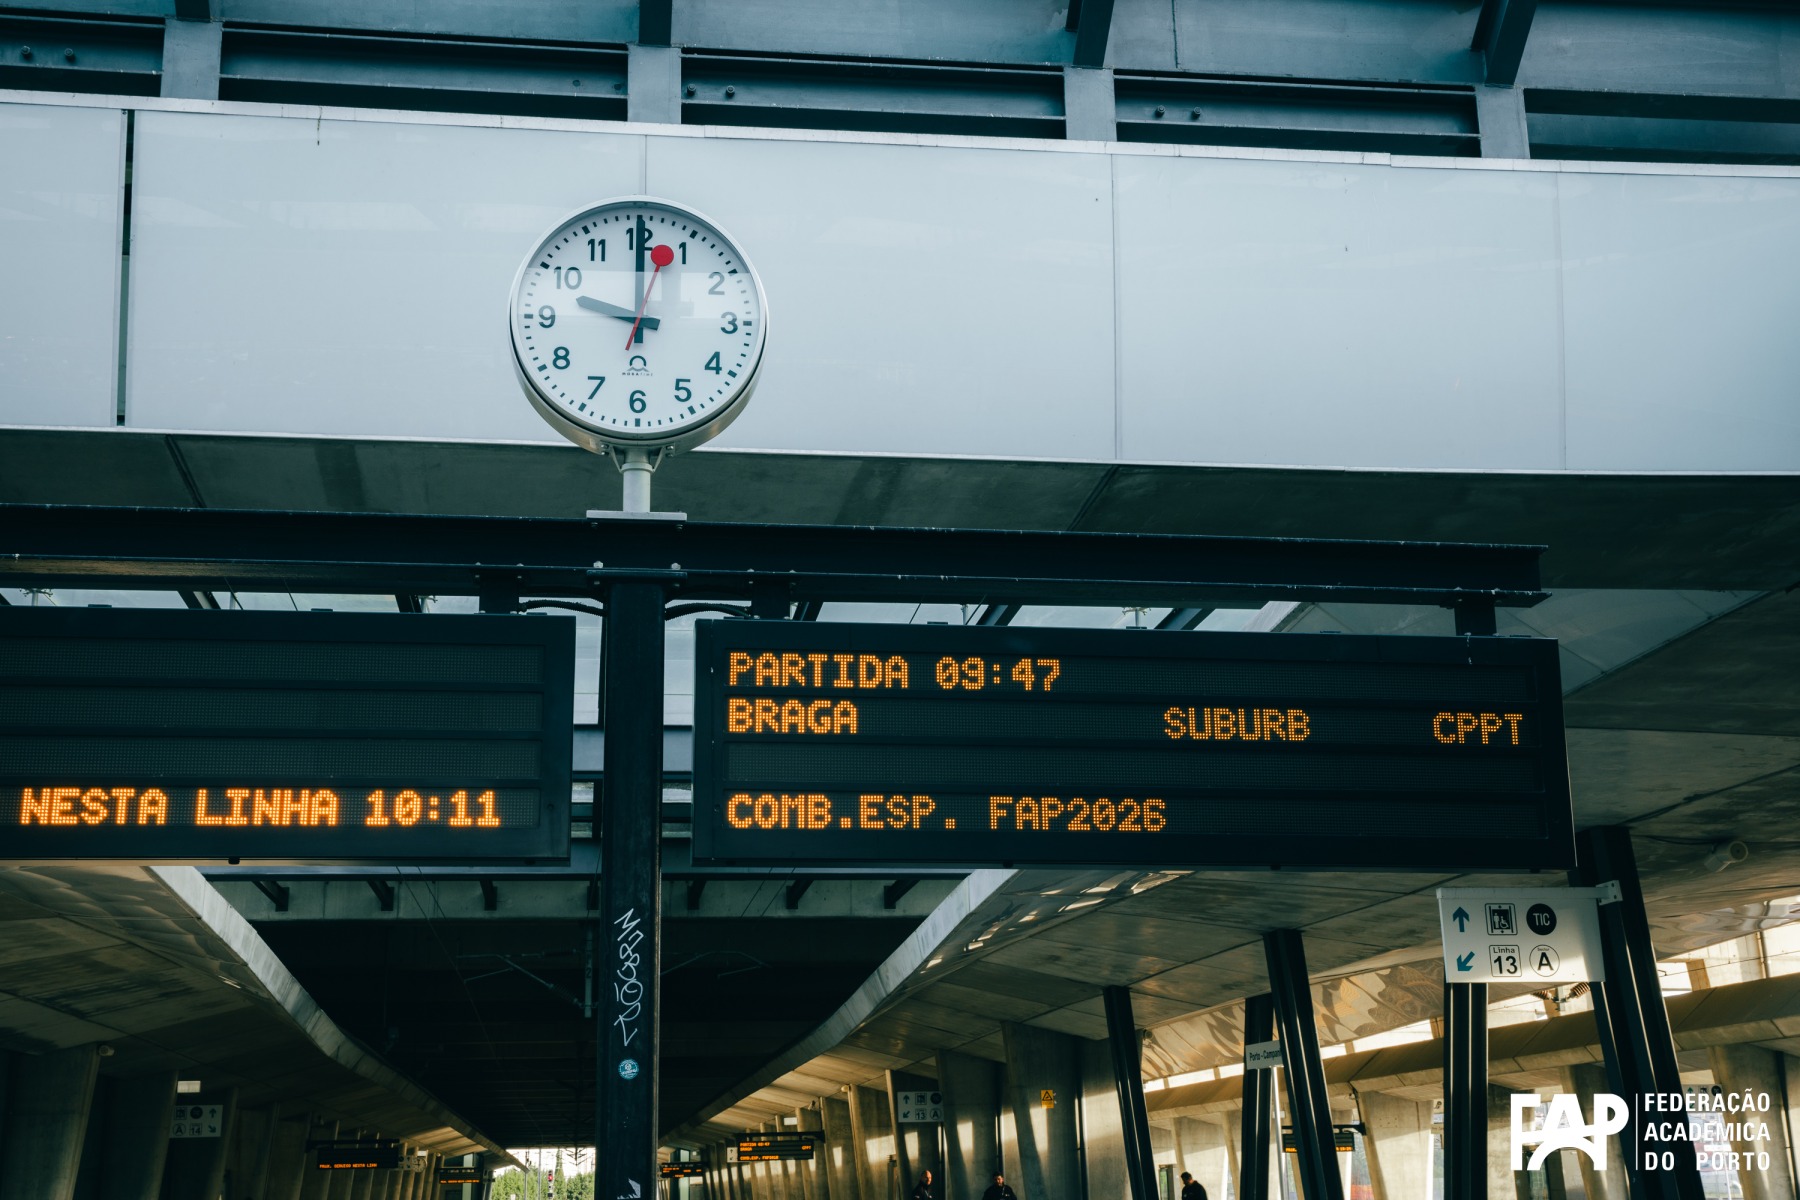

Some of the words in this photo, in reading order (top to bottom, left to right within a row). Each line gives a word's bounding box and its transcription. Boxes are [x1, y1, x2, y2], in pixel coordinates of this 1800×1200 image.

[587, 238, 606, 262] 11
[678, 241, 687, 265] 1
[553, 266, 582, 290] 10
[708, 272, 725, 295] 2
[538, 305, 556, 328] 9
[720, 311, 738, 334] 3
[552, 346, 571, 370] 8
[704, 351, 723, 375] 4
[587, 376, 606, 400] 7
[674, 378, 692, 402] 5
[629, 390, 647, 414] 6
[729, 652, 909, 690] PARTIDA
[936, 656, 1060, 692] 09:47
[728, 698, 858, 734] BRAGA
[1164, 707, 1311, 742] SUBURB
[1433, 712, 1524, 746] CPPT
[20, 786, 168, 826] NESTA
[195, 788, 340, 827] LINHA
[364, 789, 502, 828] 10:11
[727, 793, 957, 831] COMB.ESP.
[990, 796, 1167, 833] FAP2026
[1532, 913, 1550, 926] TIC
[1493, 955, 1518, 975] 13
[1537, 952, 1554, 971] A
